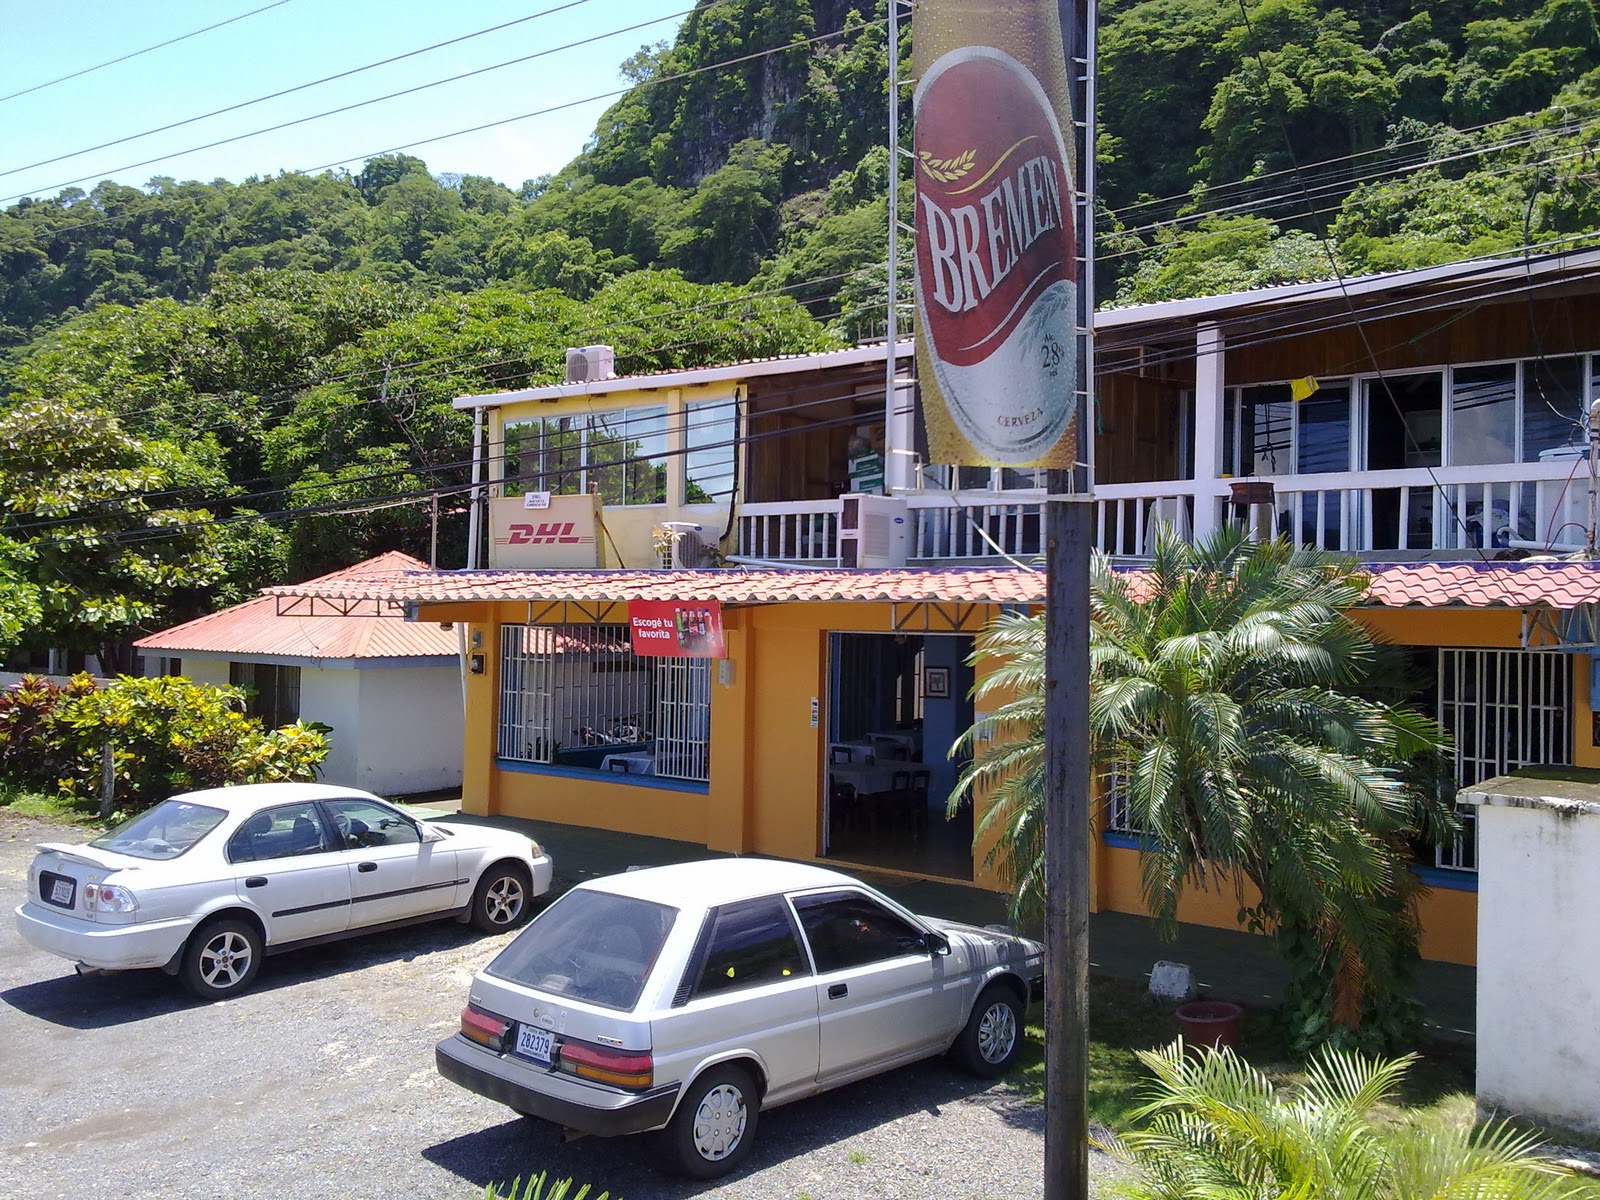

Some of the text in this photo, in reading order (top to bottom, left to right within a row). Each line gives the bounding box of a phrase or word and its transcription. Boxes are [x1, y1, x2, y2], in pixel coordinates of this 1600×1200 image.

[919, 155, 1064, 313] BREMEN
[997, 407, 1045, 427] CERVEZA
[508, 522, 580, 545] DHL
[632, 617, 673, 629] Escogé tu
[638, 628, 670, 639] favorita
[520, 1032, 550, 1054] 282379
